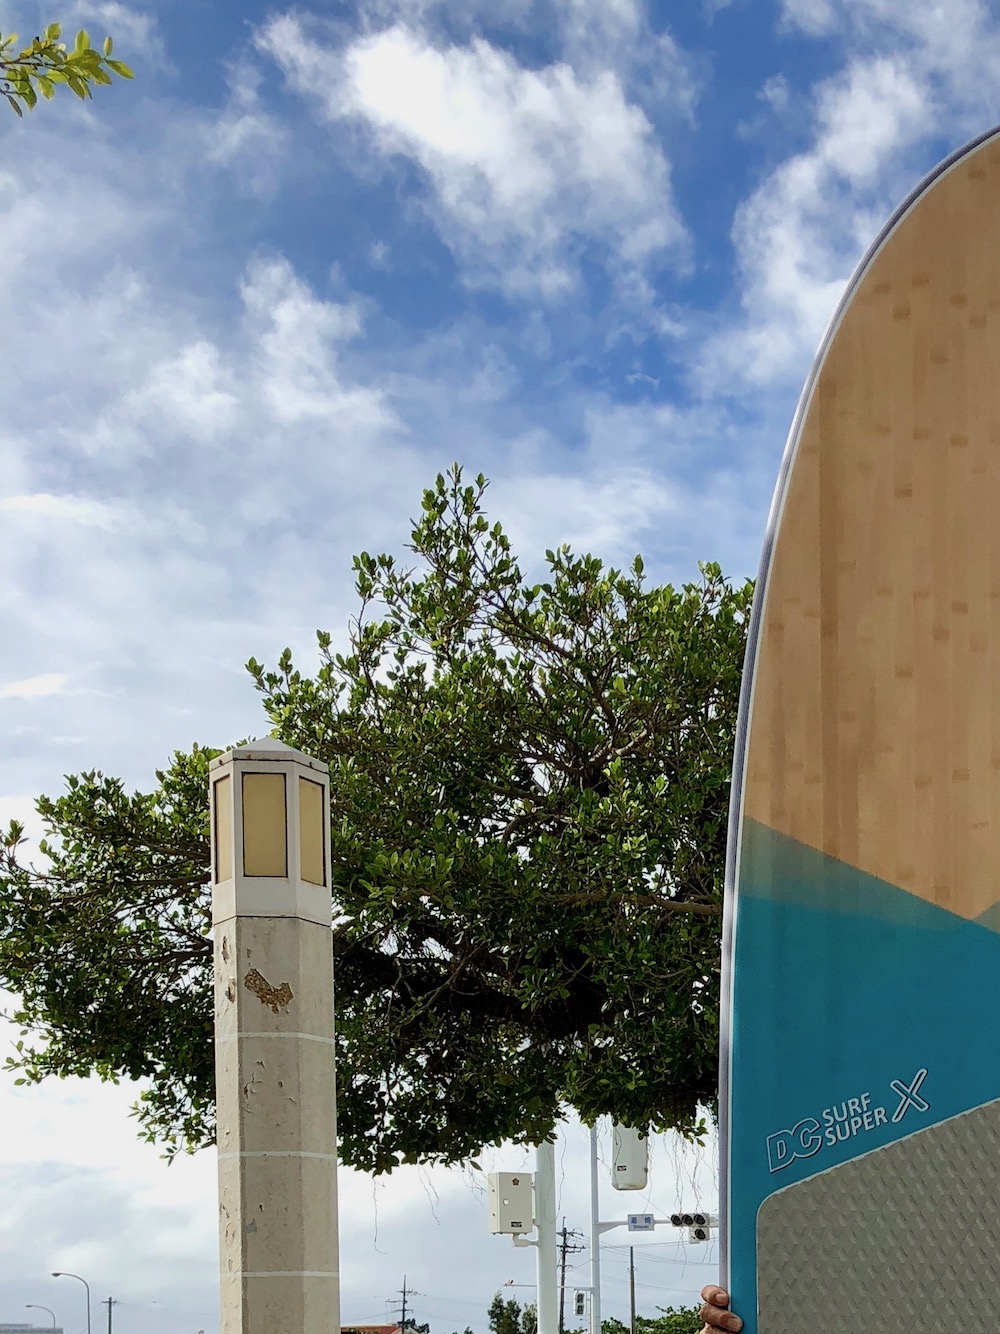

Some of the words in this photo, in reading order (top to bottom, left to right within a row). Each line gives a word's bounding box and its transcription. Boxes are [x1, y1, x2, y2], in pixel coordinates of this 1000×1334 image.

[766, 1117, 823, 1173] DC
[822, 1092, 872, 1127] SURF
[824, 1106, 888, 1147] SUPER
[889, 1068, 930, 1123] X
